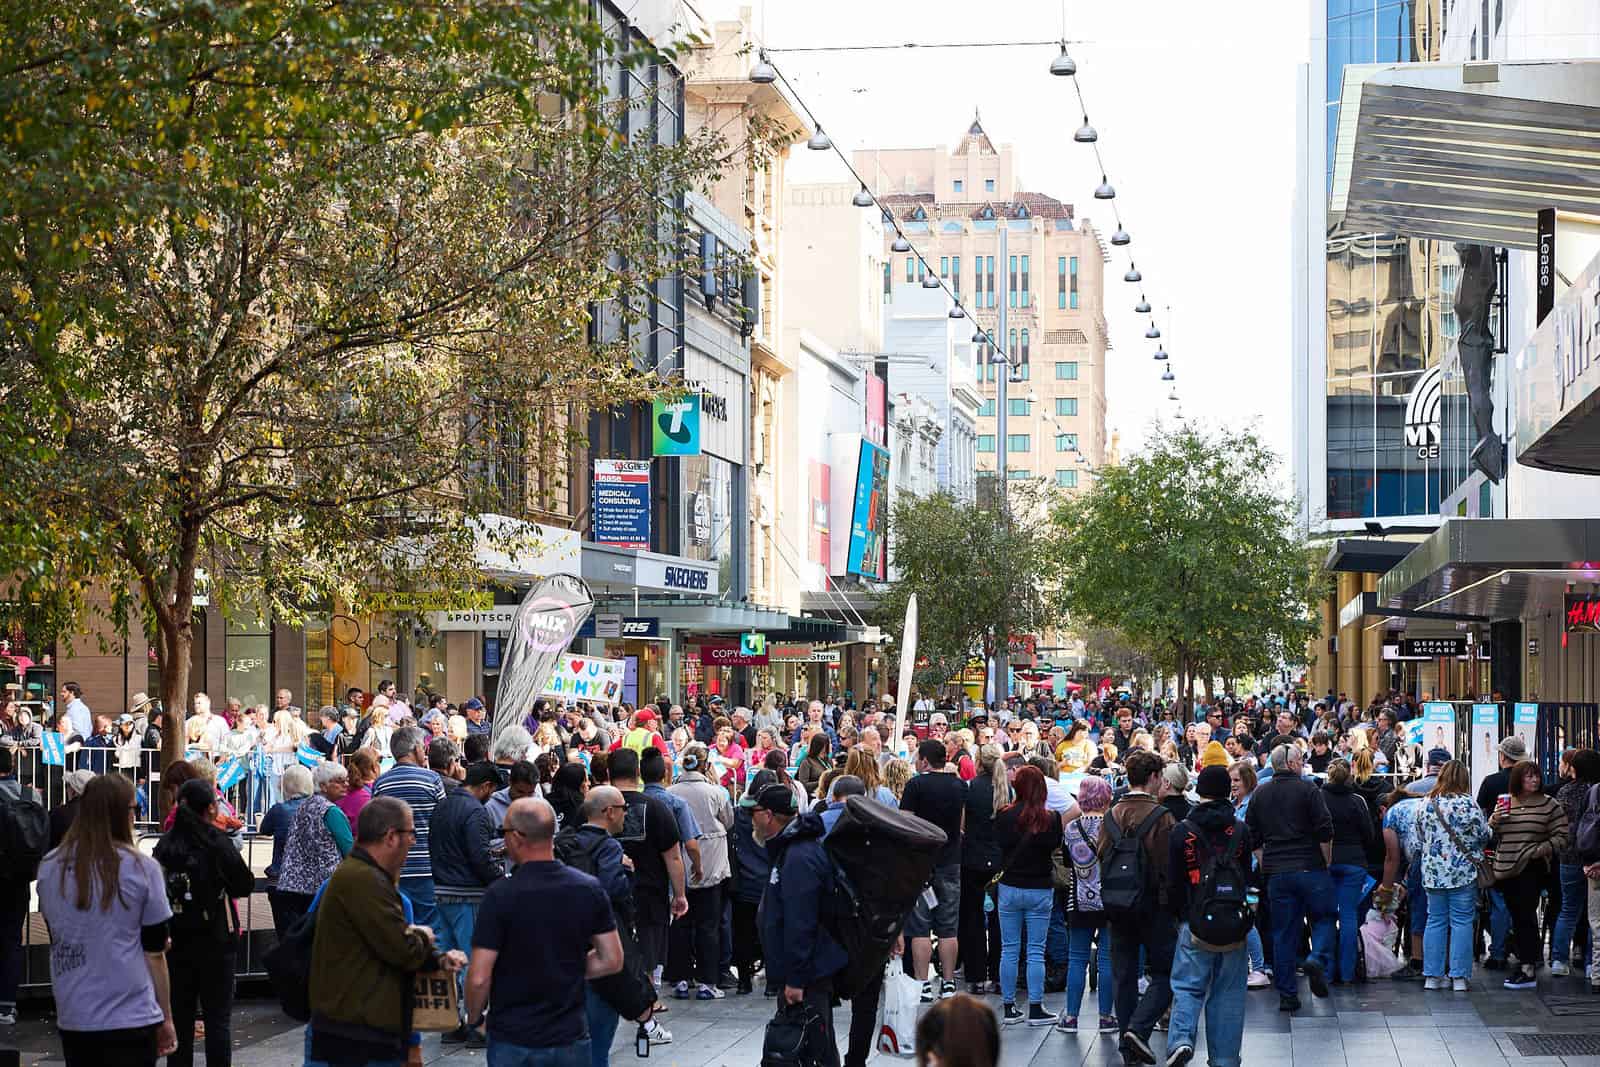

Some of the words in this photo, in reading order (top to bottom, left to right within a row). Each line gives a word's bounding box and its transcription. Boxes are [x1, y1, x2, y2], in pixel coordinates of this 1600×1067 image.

[1541, 233, 1553, 287] Lease
[664, 566, 709, 591] SKECHERS
[530, 613, 567, 632] MIX
[622, 622, 650, 633] RS
[712, 649, 756, 659] COPY
[810, 652, 836, 661] Store
[588, 661, 600, 677] U
[546, 676, 602, 697] SAMMY
